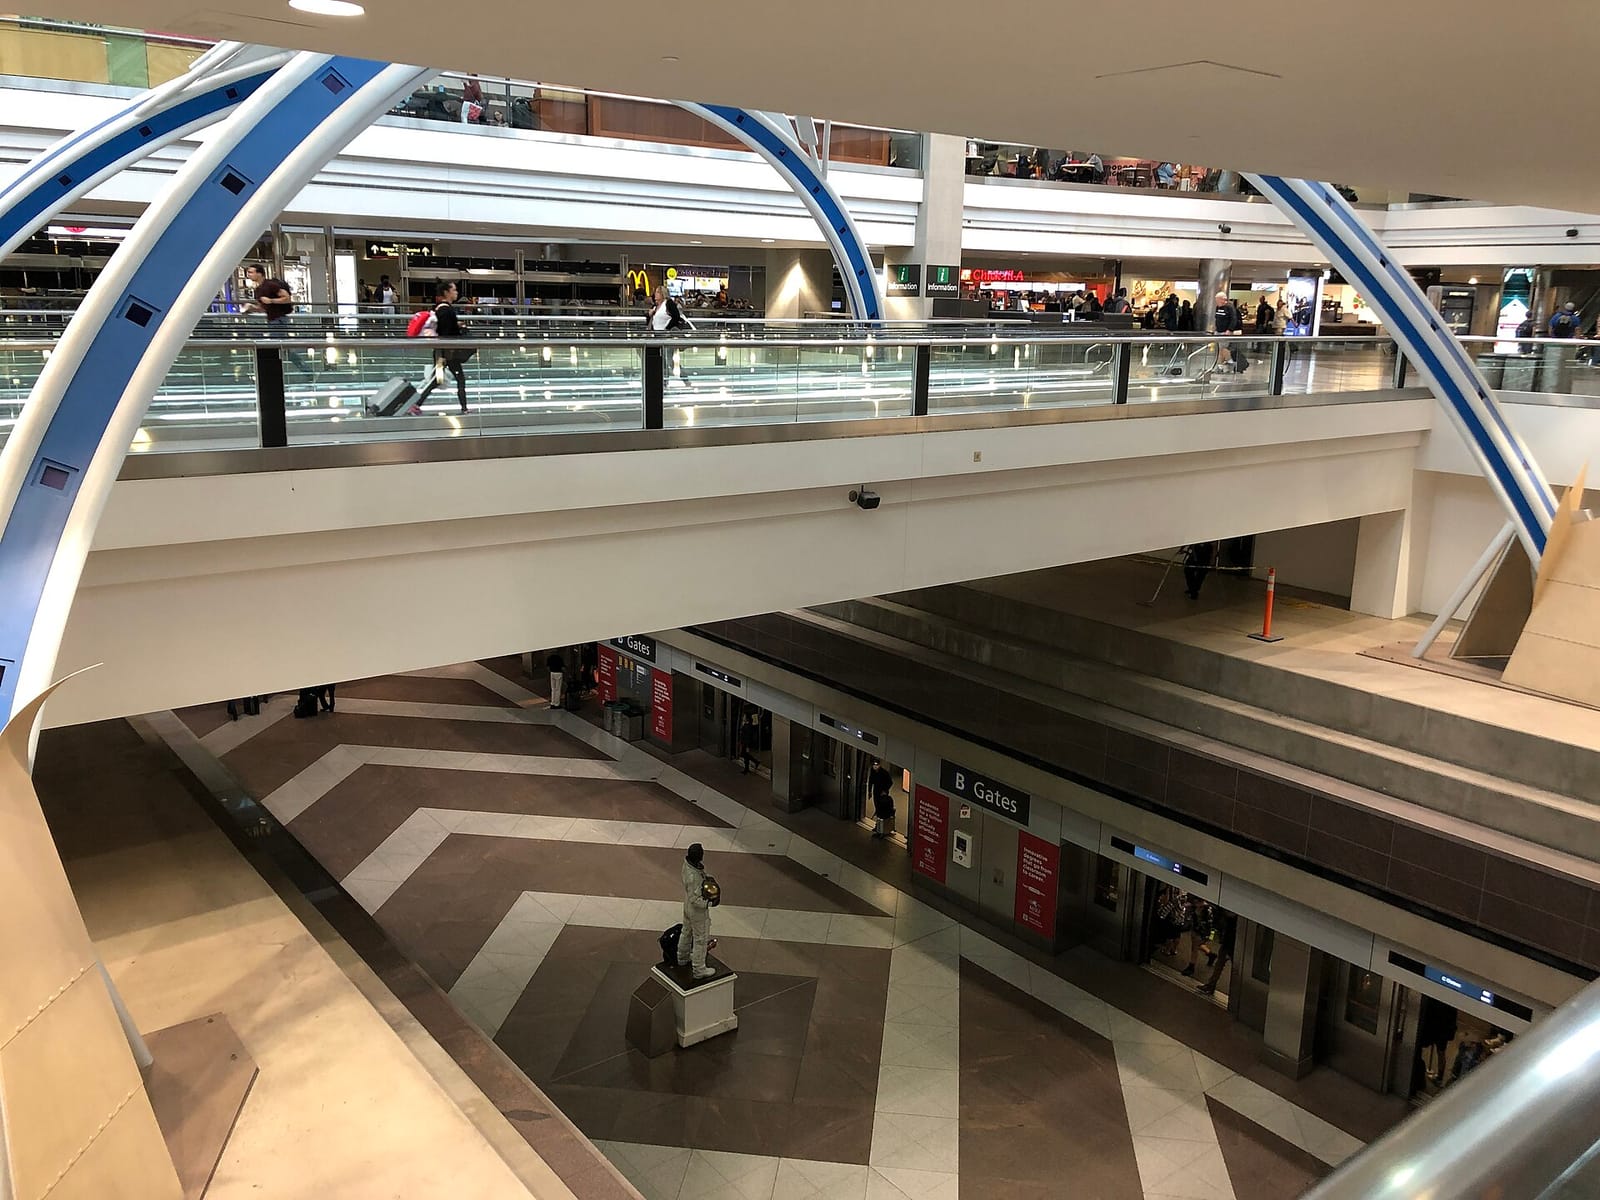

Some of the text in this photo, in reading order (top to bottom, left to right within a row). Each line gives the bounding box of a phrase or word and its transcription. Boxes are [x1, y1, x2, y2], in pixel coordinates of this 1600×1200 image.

[888, 281, 918, 290] Information
[927, 282, 958, 291] Information
[627, 636, 650, 656] Gates
[955, 772, 1017, 814] B Gates
